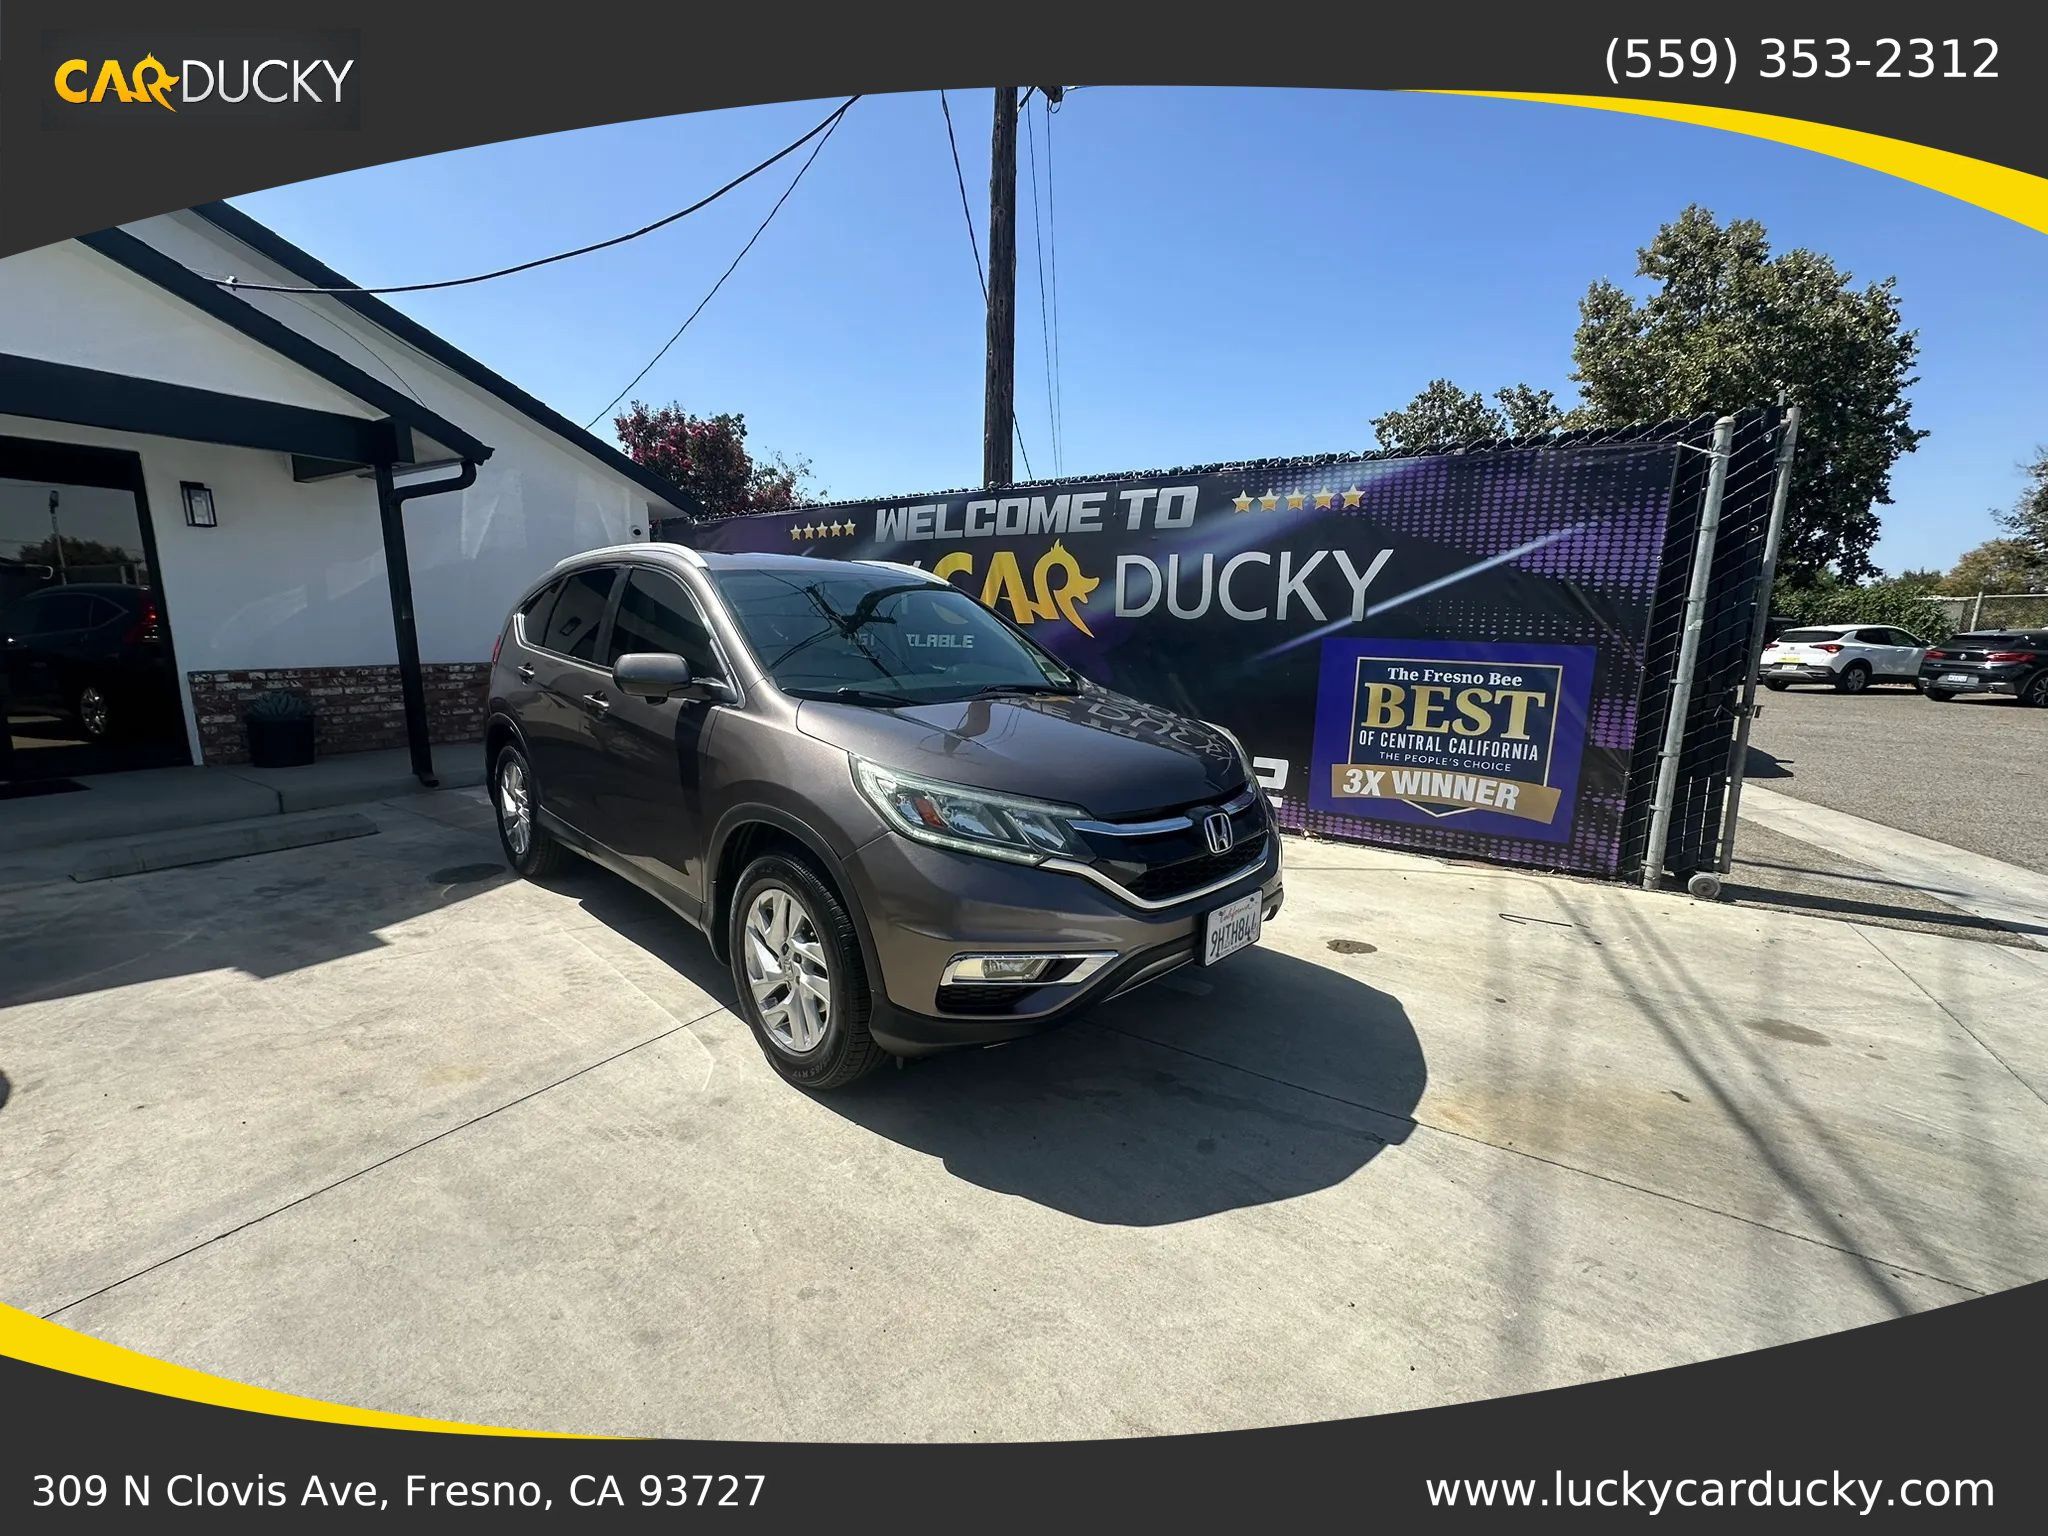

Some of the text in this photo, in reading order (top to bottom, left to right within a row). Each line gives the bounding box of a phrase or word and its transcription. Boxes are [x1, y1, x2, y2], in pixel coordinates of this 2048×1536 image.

[875, 485, 1199, 543] WELCOME TO
[1115, 549, 1394, 621] DUCKY
[1388, 667, 1523, 686] The Fresno Bee
[1361, 682, 1546, 740] BEST
[1359, 730, 1538, 761] OF CENTRAL CALIFORNIA
[1379, 751, 1511, 772] THE PEOPLE'S CHOICE
[1342, 768, 1520, 811] 3X WINNER
